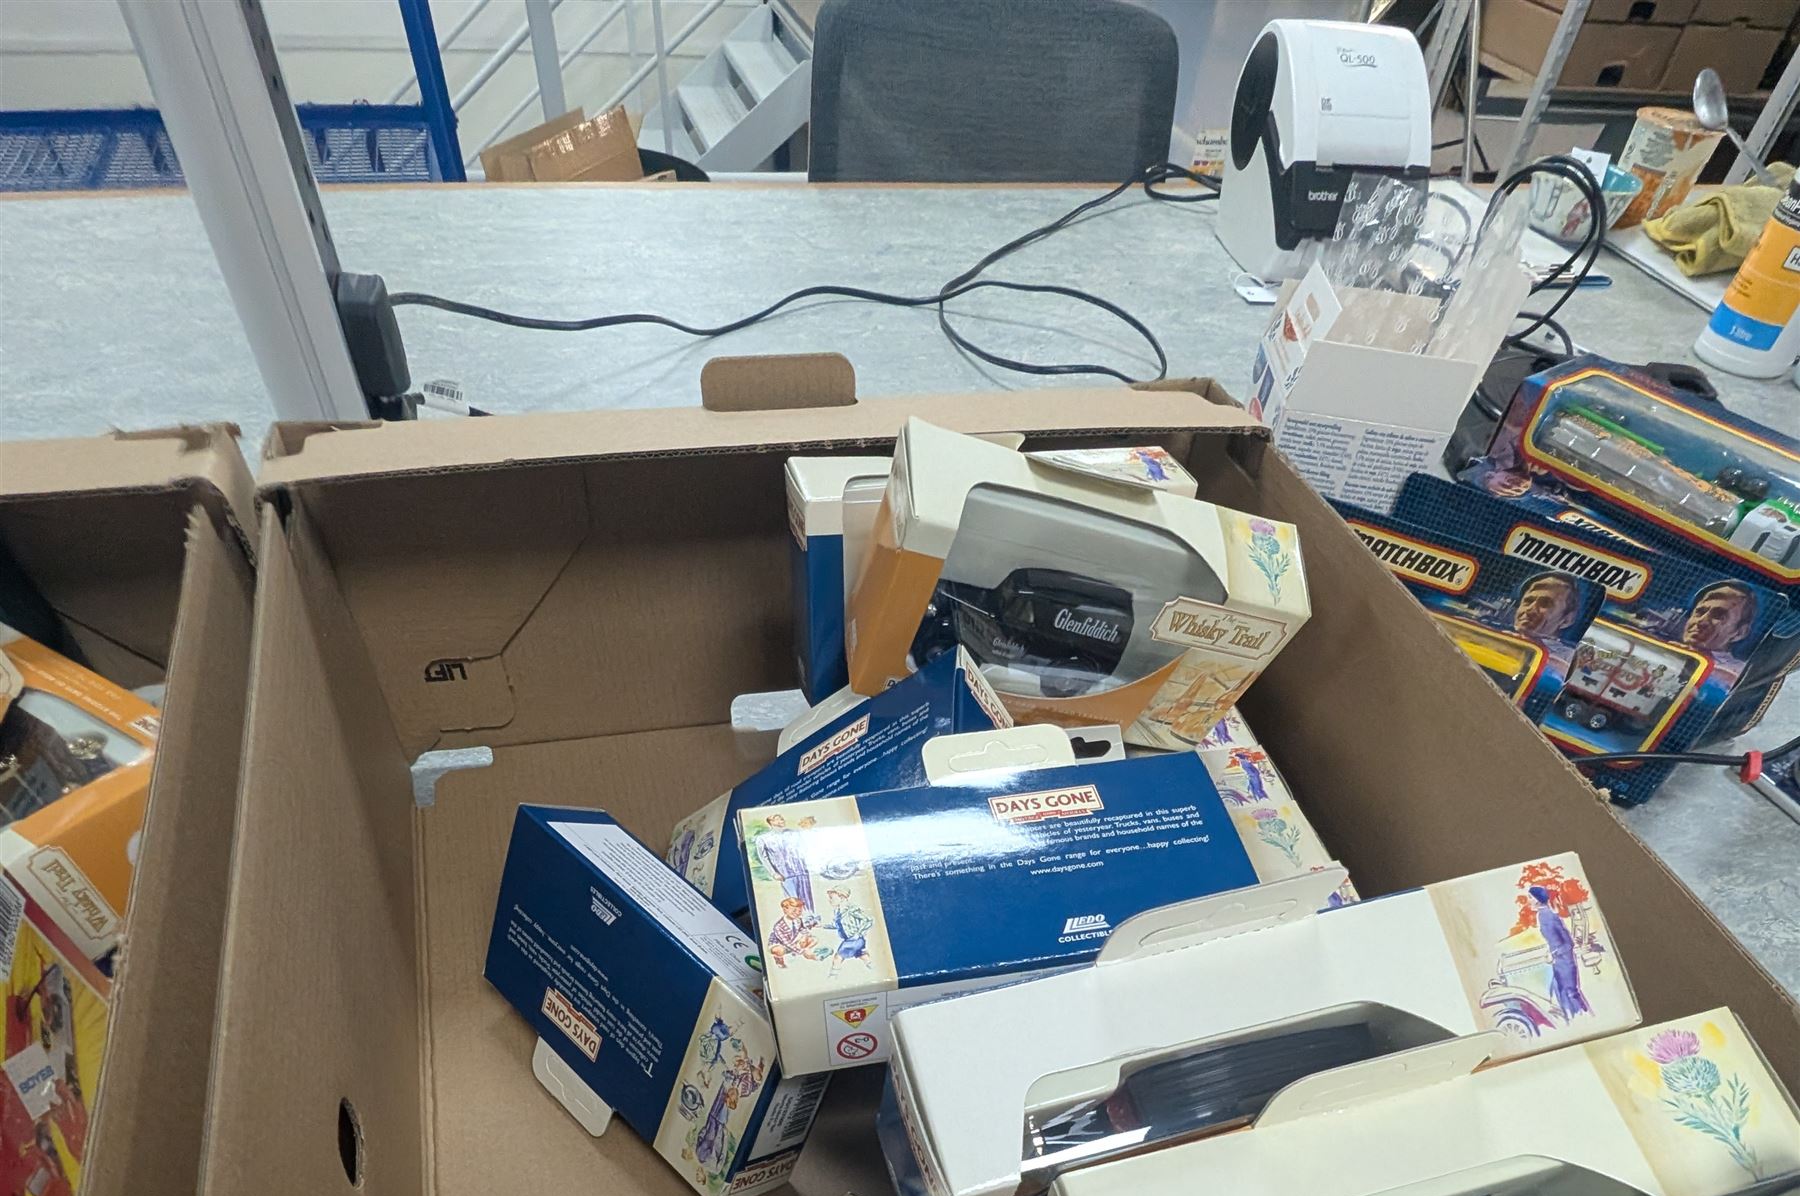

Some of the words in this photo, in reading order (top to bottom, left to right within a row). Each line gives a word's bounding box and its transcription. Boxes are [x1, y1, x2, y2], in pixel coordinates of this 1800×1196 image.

[1308, 190, 1338, 201] brother
[1054, 608, 1119, 642] Glenfiddich
[1168, 610, 1228, 646] Whisky
[1230, 625, 1271, 650] Trail
[799, 743, 831, 767] DAYS
[830, 720, 868, 747] GONE
[995, 797, 1041, 814] DAYS
[1044, 789, 1095, 807] GONE
[1049, 822, 1061, 830] are
[1063, 817, 1101, 828] beautifully
[1103, 811, 1143, 823] recaptured
[1154, 807, 1169, 816] this
[1170, 804, 1196, 814] superb
[1073, 831, 1100, 842] brands
[1101, 829, 1115, 839] and
[1115, 824, 1155, 837] household
[1155, 821, 1180, 831] names
[1189, 817, 1203, 827] the
[912, 869, 941, 881] There's
[944, 863, 984, 877] something
[999, 860, 1013, 869] the
[1016, 856, 1036, 867] Days
[1038, 853, 1061, 864] Gone
[1064, 850, 1087, 860] range
[1088, 847, 1101, 857] for
[1029, 859, 1104, 876] www.daysgone.com
[544, 996, 573, 1030] GONE
[572, 1024, 597, 1054] DAYS
